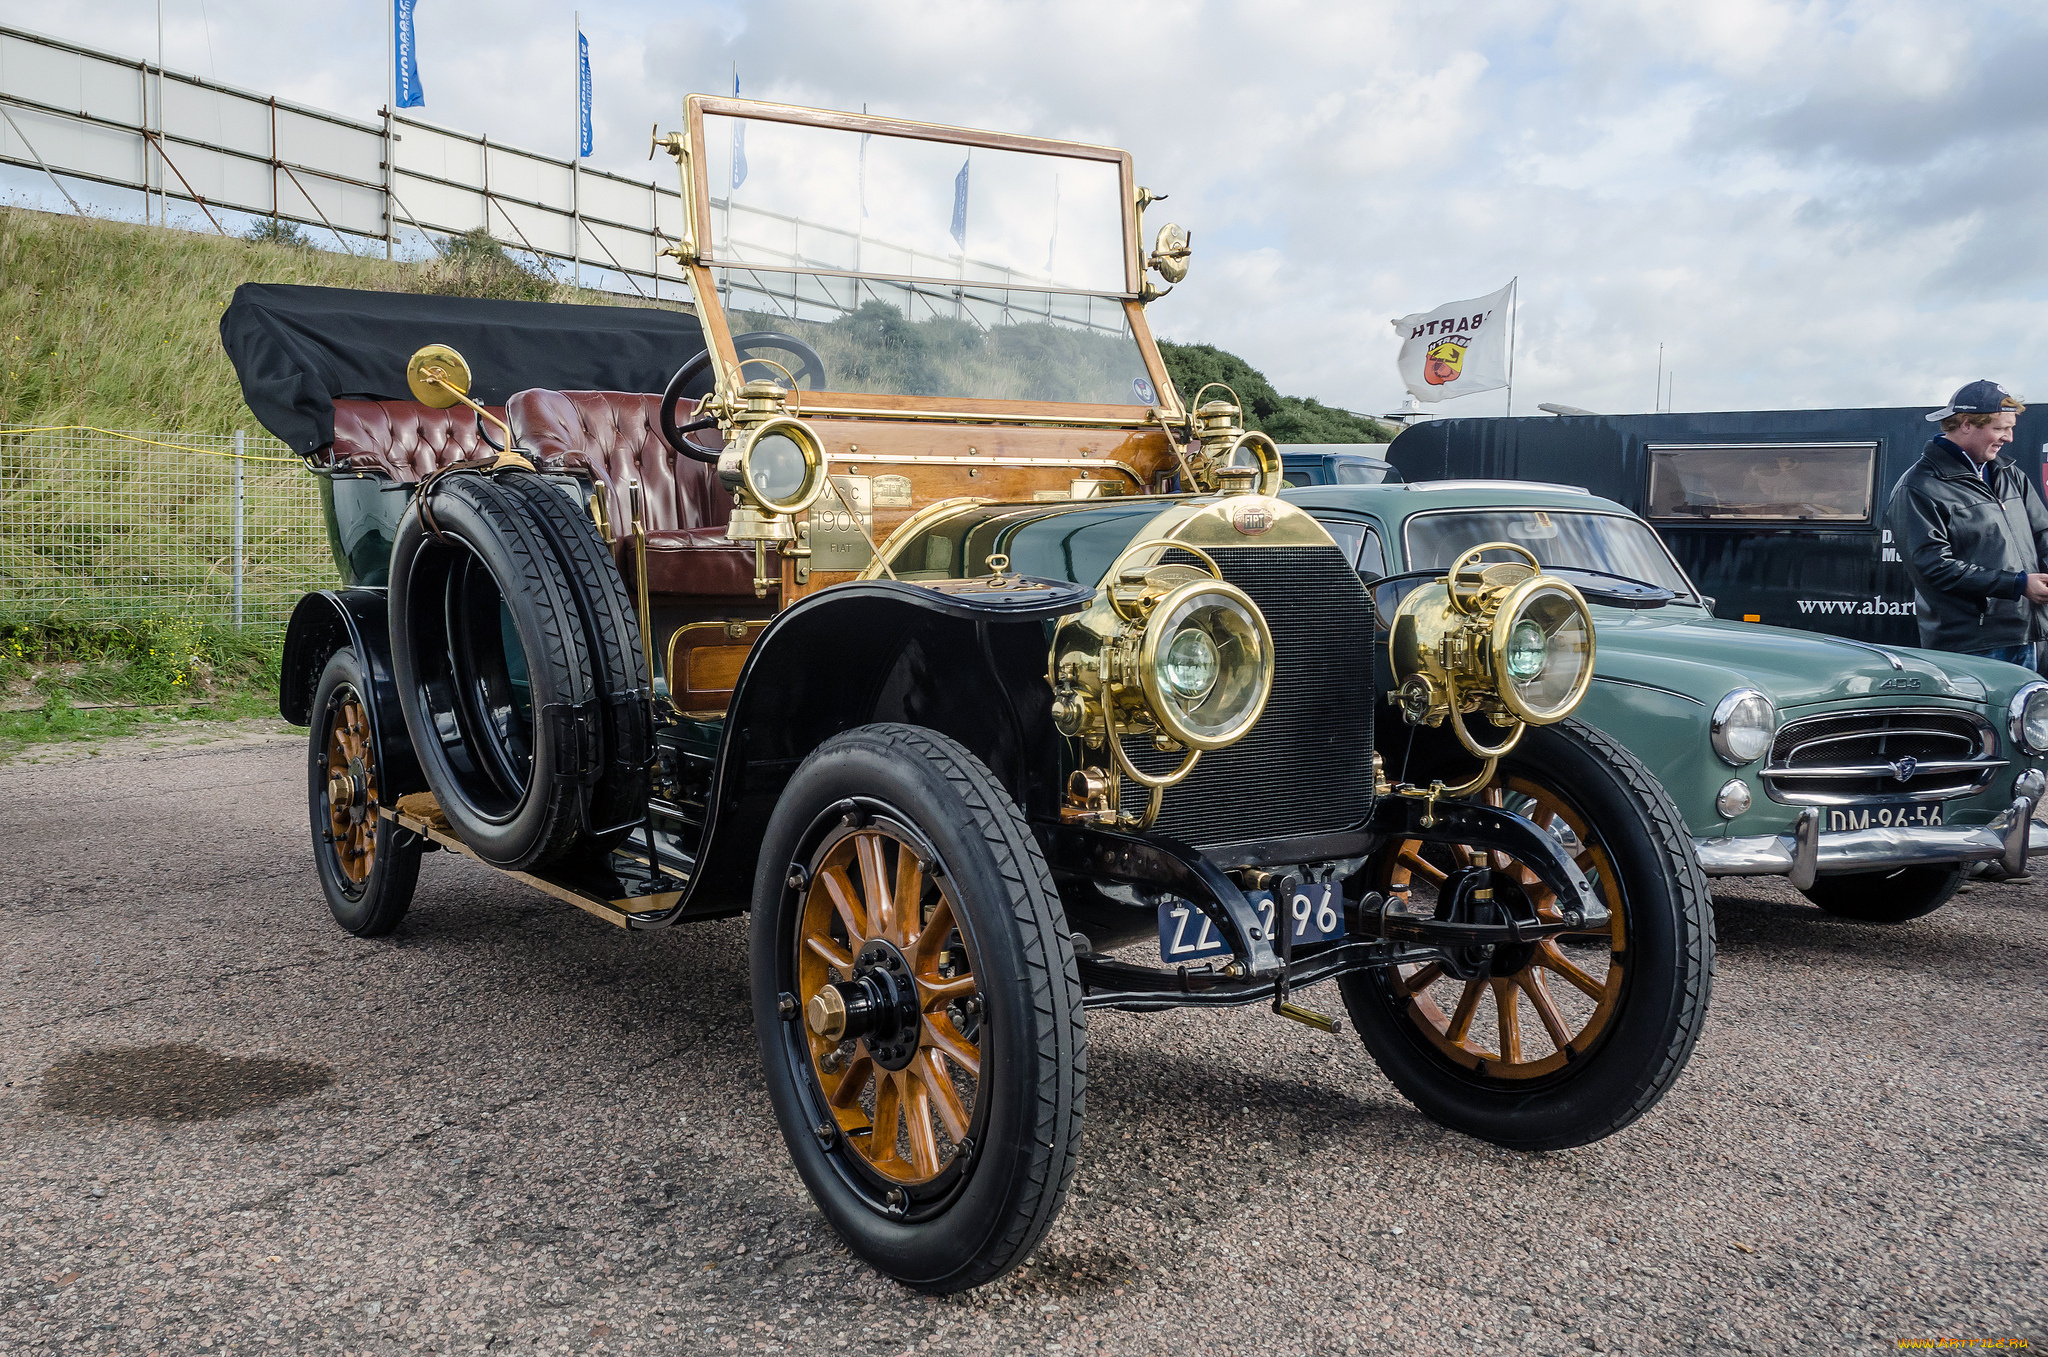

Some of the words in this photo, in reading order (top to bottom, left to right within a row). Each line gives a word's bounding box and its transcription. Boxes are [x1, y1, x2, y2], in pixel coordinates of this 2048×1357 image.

[1244, 514, 1265, 529] FIAT
[830, 543, 852, 553] FIAT
[1880, 677, 1921, 689] 403
[1831, 806, 1942, 832] DM-96-56
